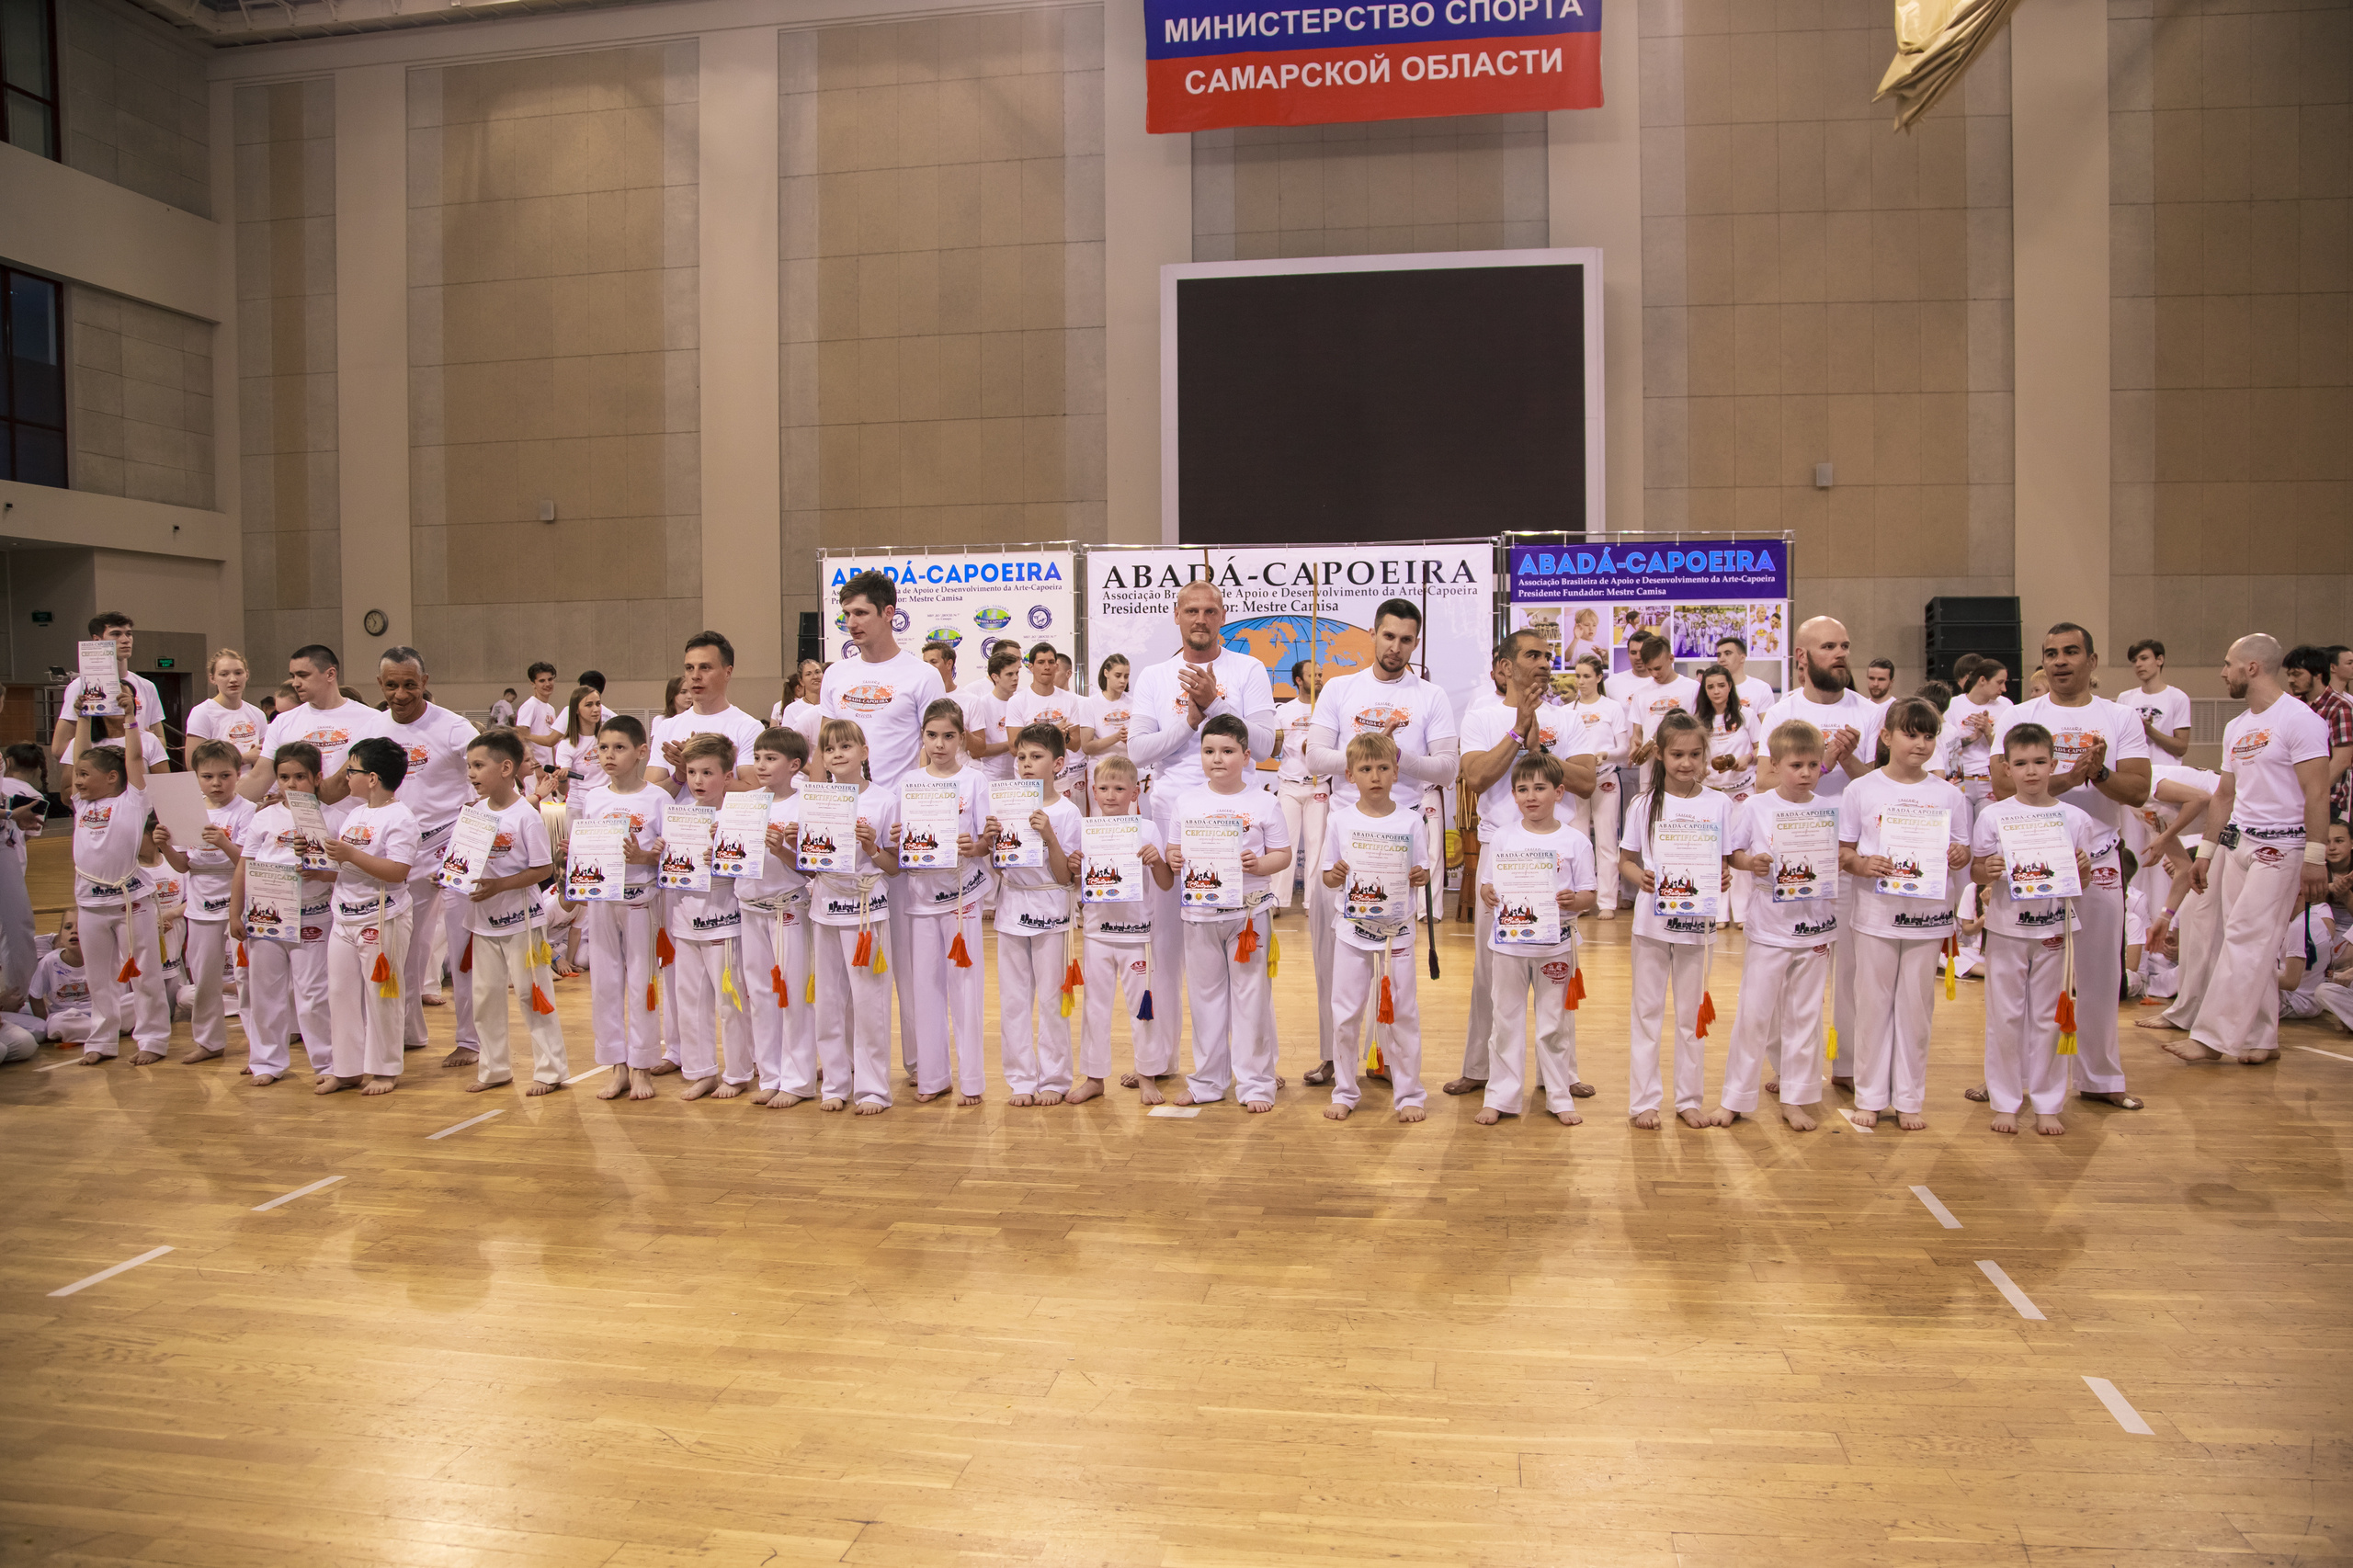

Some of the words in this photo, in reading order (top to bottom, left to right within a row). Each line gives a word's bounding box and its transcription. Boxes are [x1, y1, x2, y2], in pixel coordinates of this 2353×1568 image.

[1165, 2, 1435, 43] МИНИСТЕРСТВО
[1445, 0, 1584, 25] СПОРТА
[1185, 52, 1390, 95] САМАРСКОЙ
[1401, 48, 1563, 81] ОБЛАСТИ
[1518, 546, 1776, 575] ABADÁ-CAPOEIRA
[831, 560, 1062, 586] ADÁ-CAPOEIRA
[1518, 578, 1560, 587] Associação
[1561, 577, 1597, 585] Brasileira
[1599, 576, 1608, 585] de
[1610, 576, 1634, 586] Apoio
[1642, 575, 1709, 585] Desenvolvimento
[1722, 574, 1776, 585] Arte-Capoeira
[903, 586, 912, 595] de
[913, 586, 934, 596] Apoio
[940, 585, 1001, 594] Desenvolvimento
[1013, 584, 1063, 593] Arte-Capoeira
[1103, 590, 1161, 602] Associação
[1235, 588, 1268, 600] Apoio
[1272, 590, 1278, 598] e
[1281, 585, 1379, 597] Desenvolvimento
[1382, 585, 1395, 597] da
[1518, 589, 1561, 597] Presidente
[1563, 588, 1605, 597] Fundador:
[1636, 587, 1666, 596] Camisa
[1103, 601, 1169, 614] Presidente
[1243, 600, 1287, 613] Mestre
[1290, 599, 1339, 613] Camisa
[803, 793, 855, 802] CERTIFICADO
[904, 791, 957, 800] CERTIFICADO
[992, 790, 1040, 800] CERTIFICADO
[666, 815, 712, 824] CERTIFICADO
[1777, 820, 1835, 830] CERTIFICADO
[1886, 816, 1942, 827] CERTIFICAD
[1086, 826, 1139, 835] CERTIFICADO
[2003, 821, 2064, 832] CERTIFICADO
[1185, 829, 1239, 837] CERTIFICADO
[1658, 834, 1718, 842] CERTIFICADO
[1352, 841, 1408, 853] CERTIFICADO
[1496, 861, 1553, 870] CERTIFICADO
[249, 870, 299, 882] CERTIFICADO
